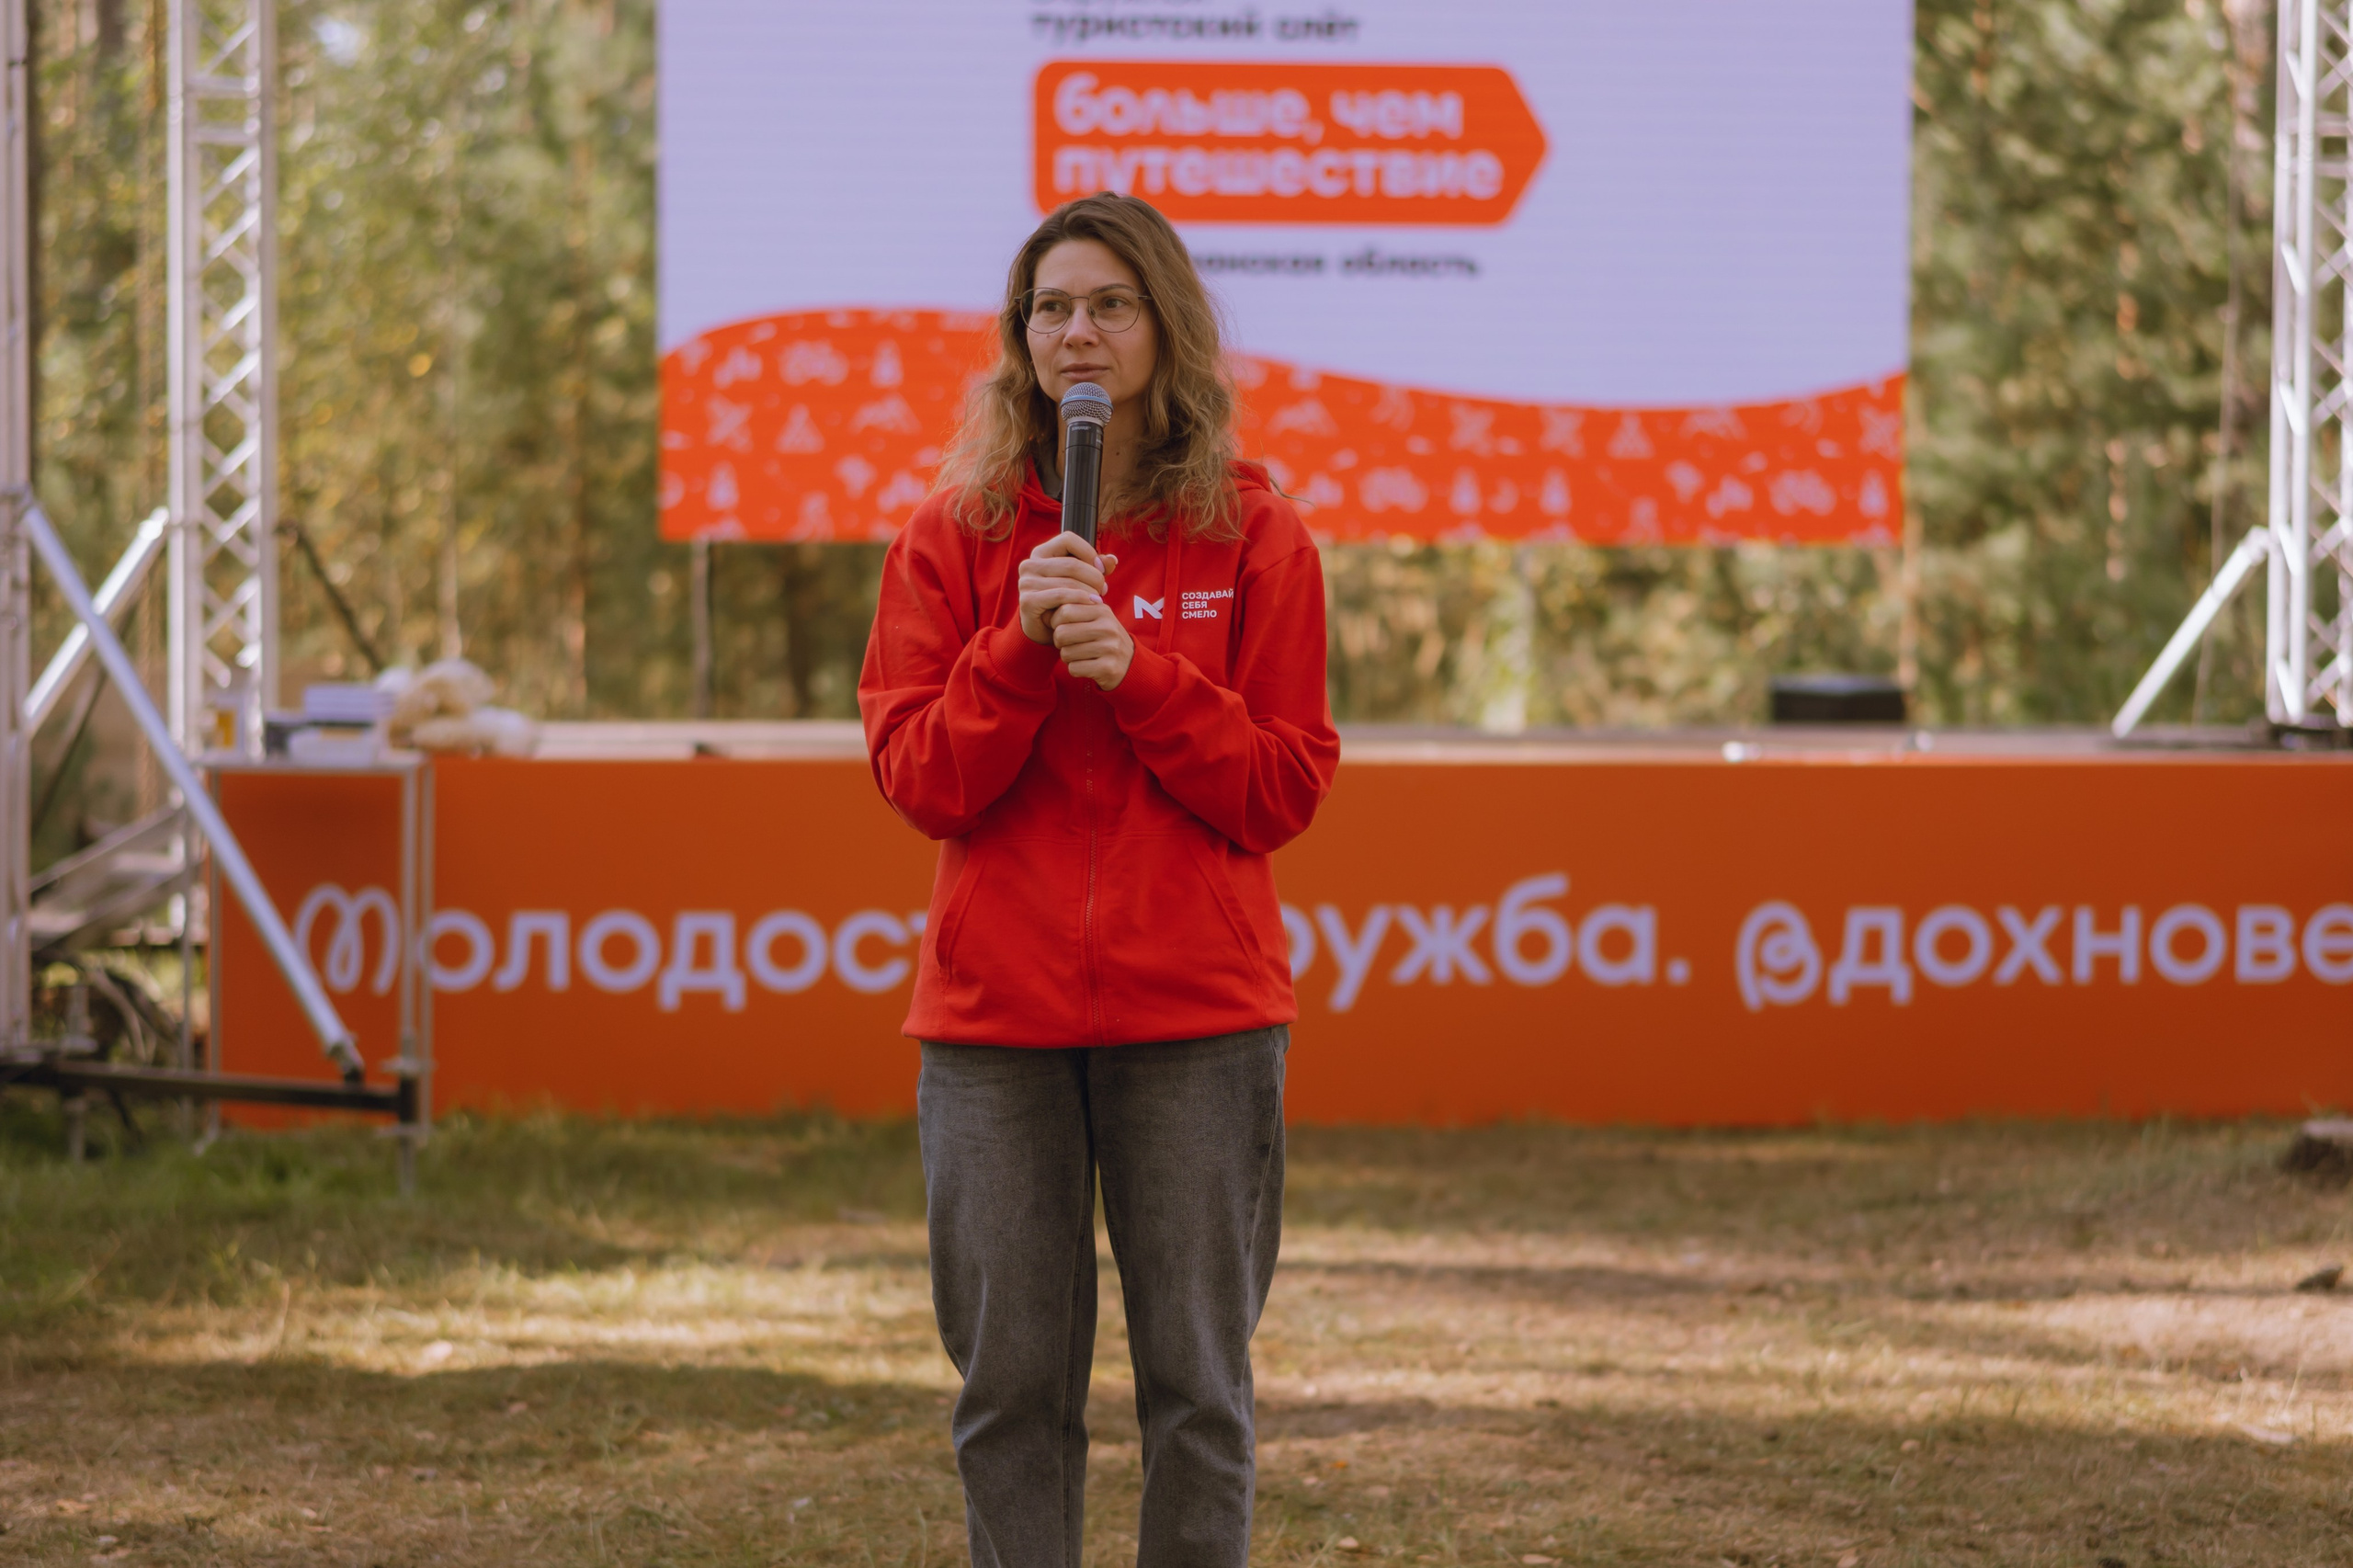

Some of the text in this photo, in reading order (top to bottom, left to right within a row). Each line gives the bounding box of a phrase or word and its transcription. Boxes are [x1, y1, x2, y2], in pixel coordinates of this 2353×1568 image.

[1052, 72, 1464, 145] больше, чем
[1052, 145, 1506, 200] путешествие
[1181, 588, 1234, 600] СОЗДАВАЙ
[1181, 600, 1208, 610] СЕБЯ
[1181, 609, 1218, 619] СМЕЛО
[295, 882, 928, 1012] Молодос
